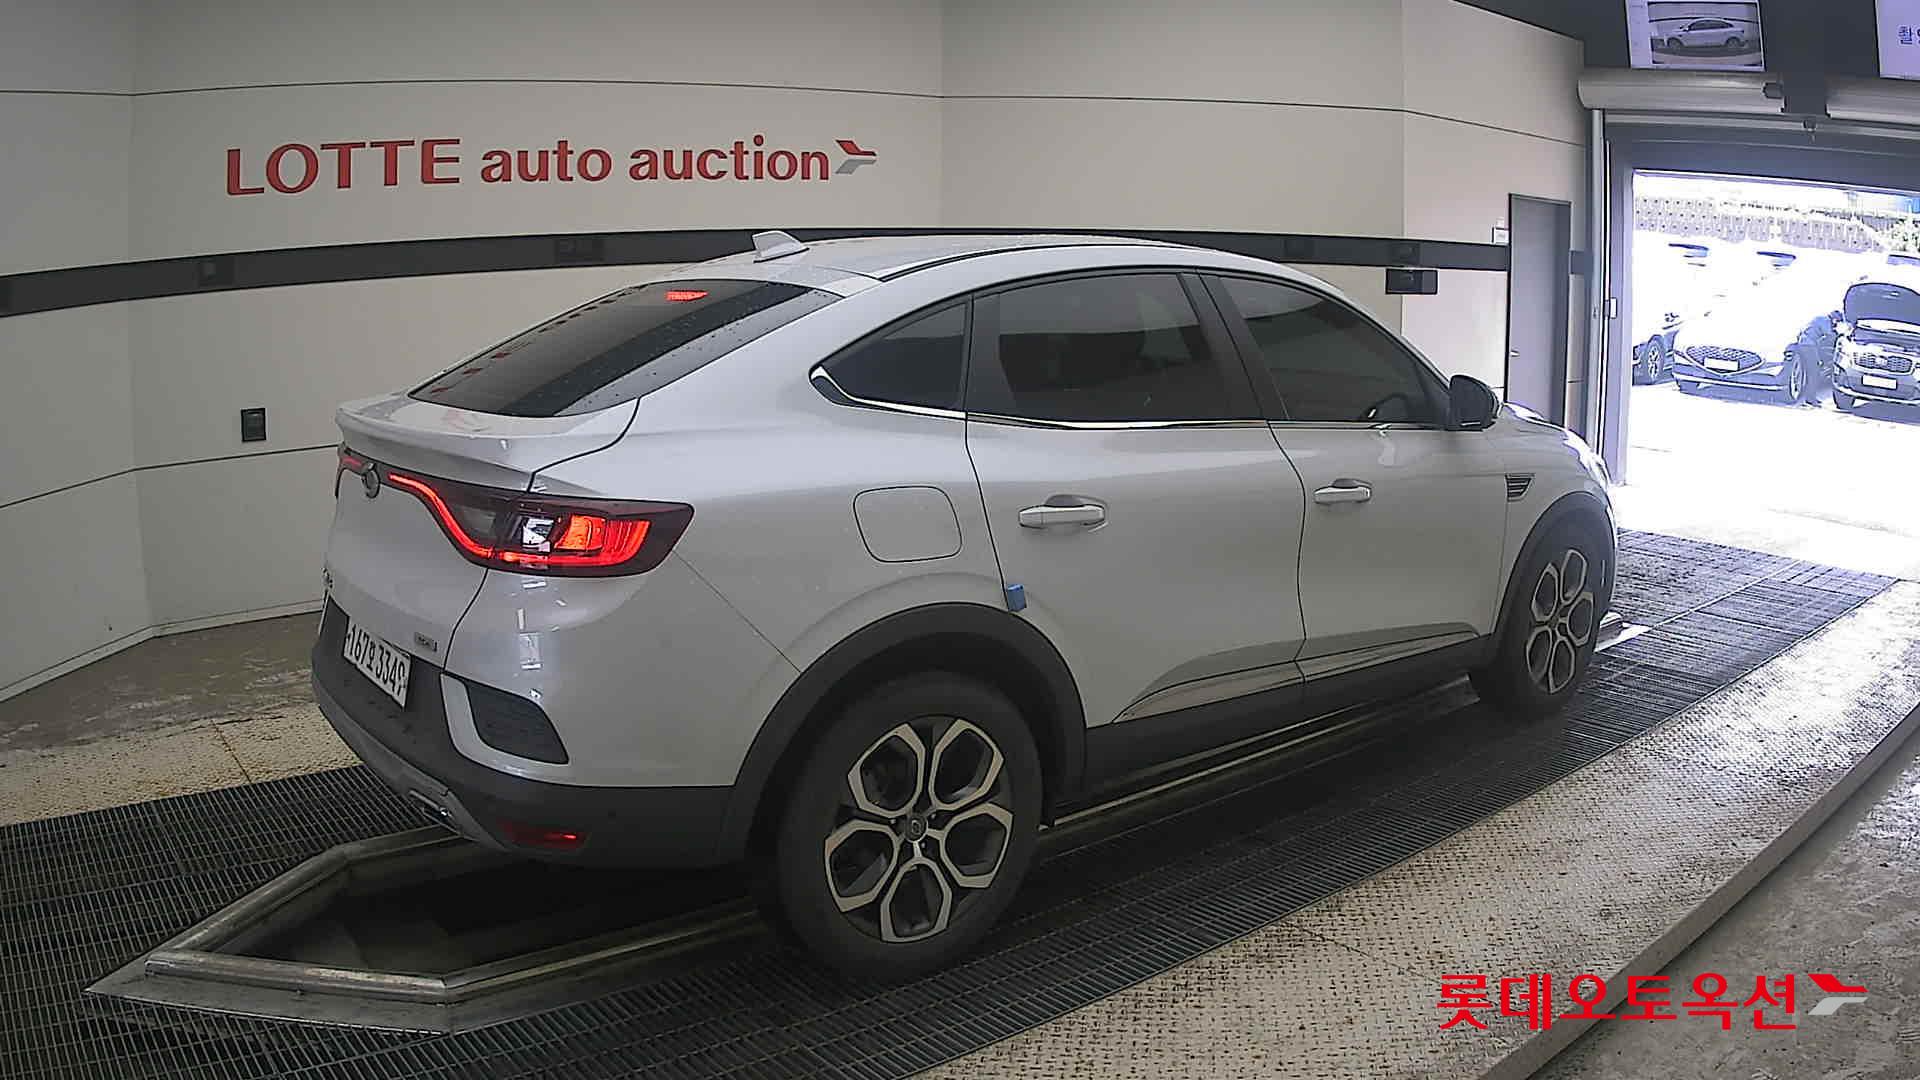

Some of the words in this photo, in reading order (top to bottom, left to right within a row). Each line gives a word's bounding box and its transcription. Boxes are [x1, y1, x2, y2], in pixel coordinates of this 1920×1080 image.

[227, 138, 460, 195] LOTTE
[480, 140, 612, 182] auto
[629, 135, 829, 181] auction
